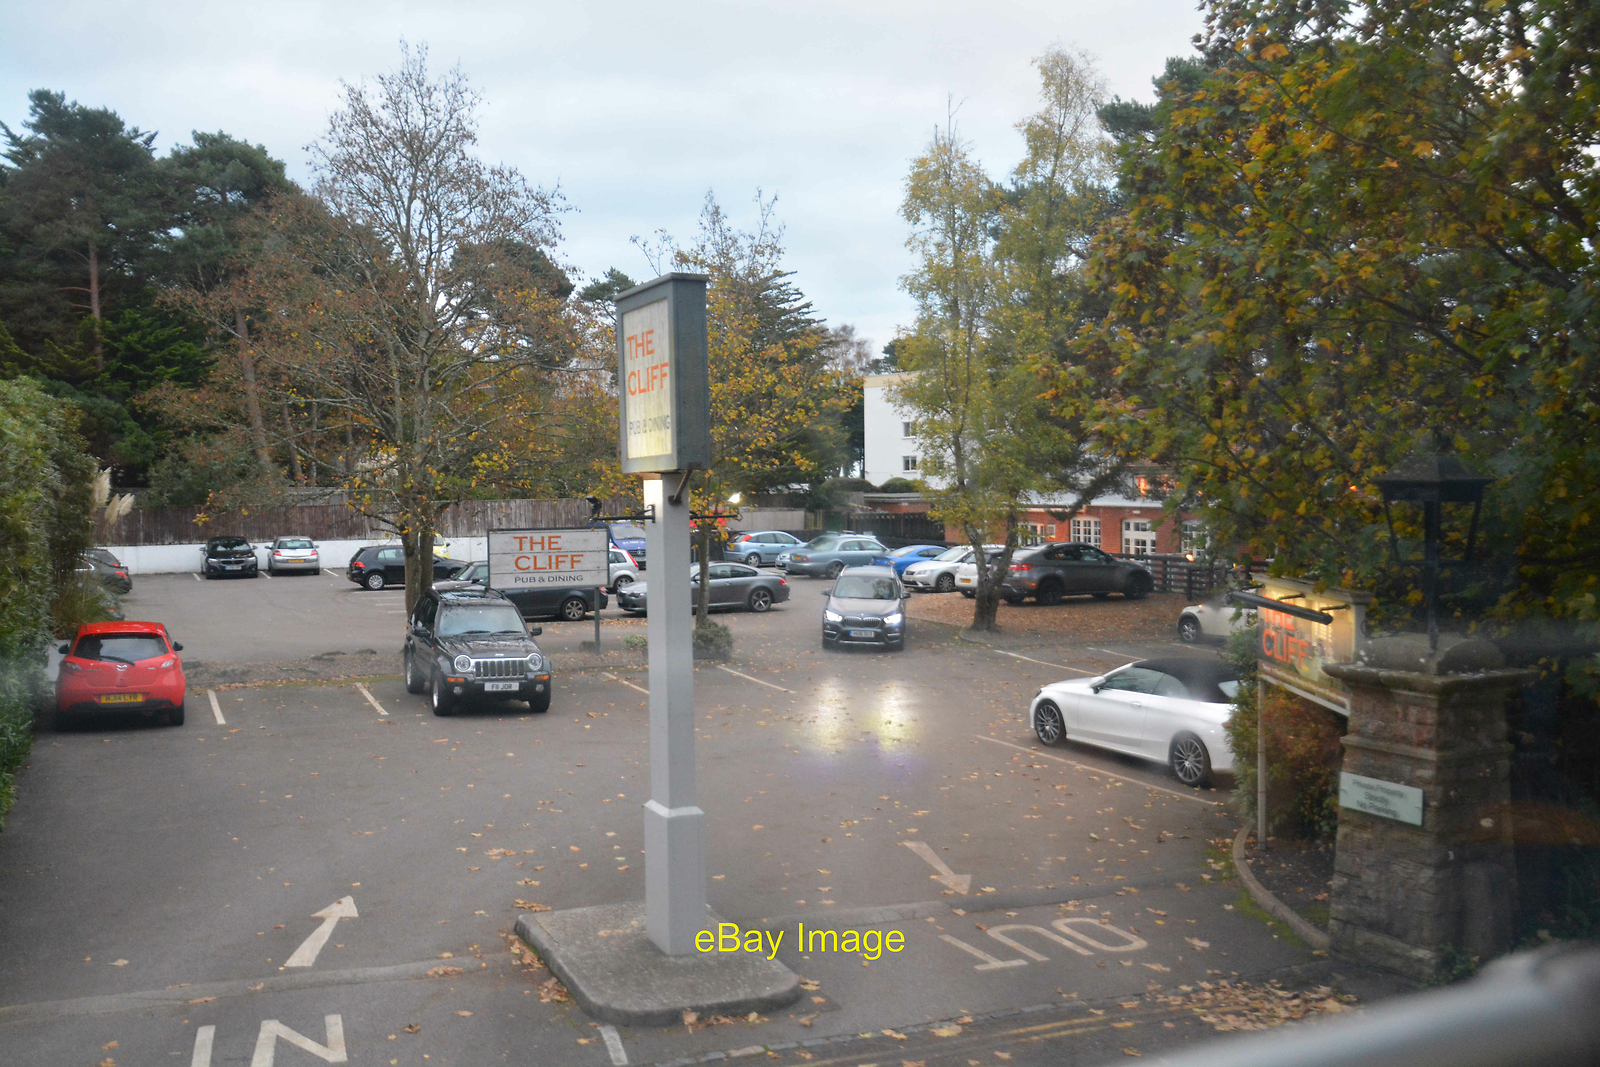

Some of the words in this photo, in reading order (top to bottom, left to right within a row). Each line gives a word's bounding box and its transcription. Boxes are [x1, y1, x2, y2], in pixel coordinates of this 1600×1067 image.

[626, 329, 655, 360] THE
[627, 362, 669, 396] CLIFF
[629, 420, 641, 435] PUB
[648, 415, 670, 432] DINING
[513, 535, 562, 551] THE
[514, 554, 584, 571] CLIFF
[547, 574, 584, 582] DINING
[1262, 628, 1309, 669] CLIFF
[937, 917, 1148, 971] OUT
[190, 1014, 348, 1067] IN
